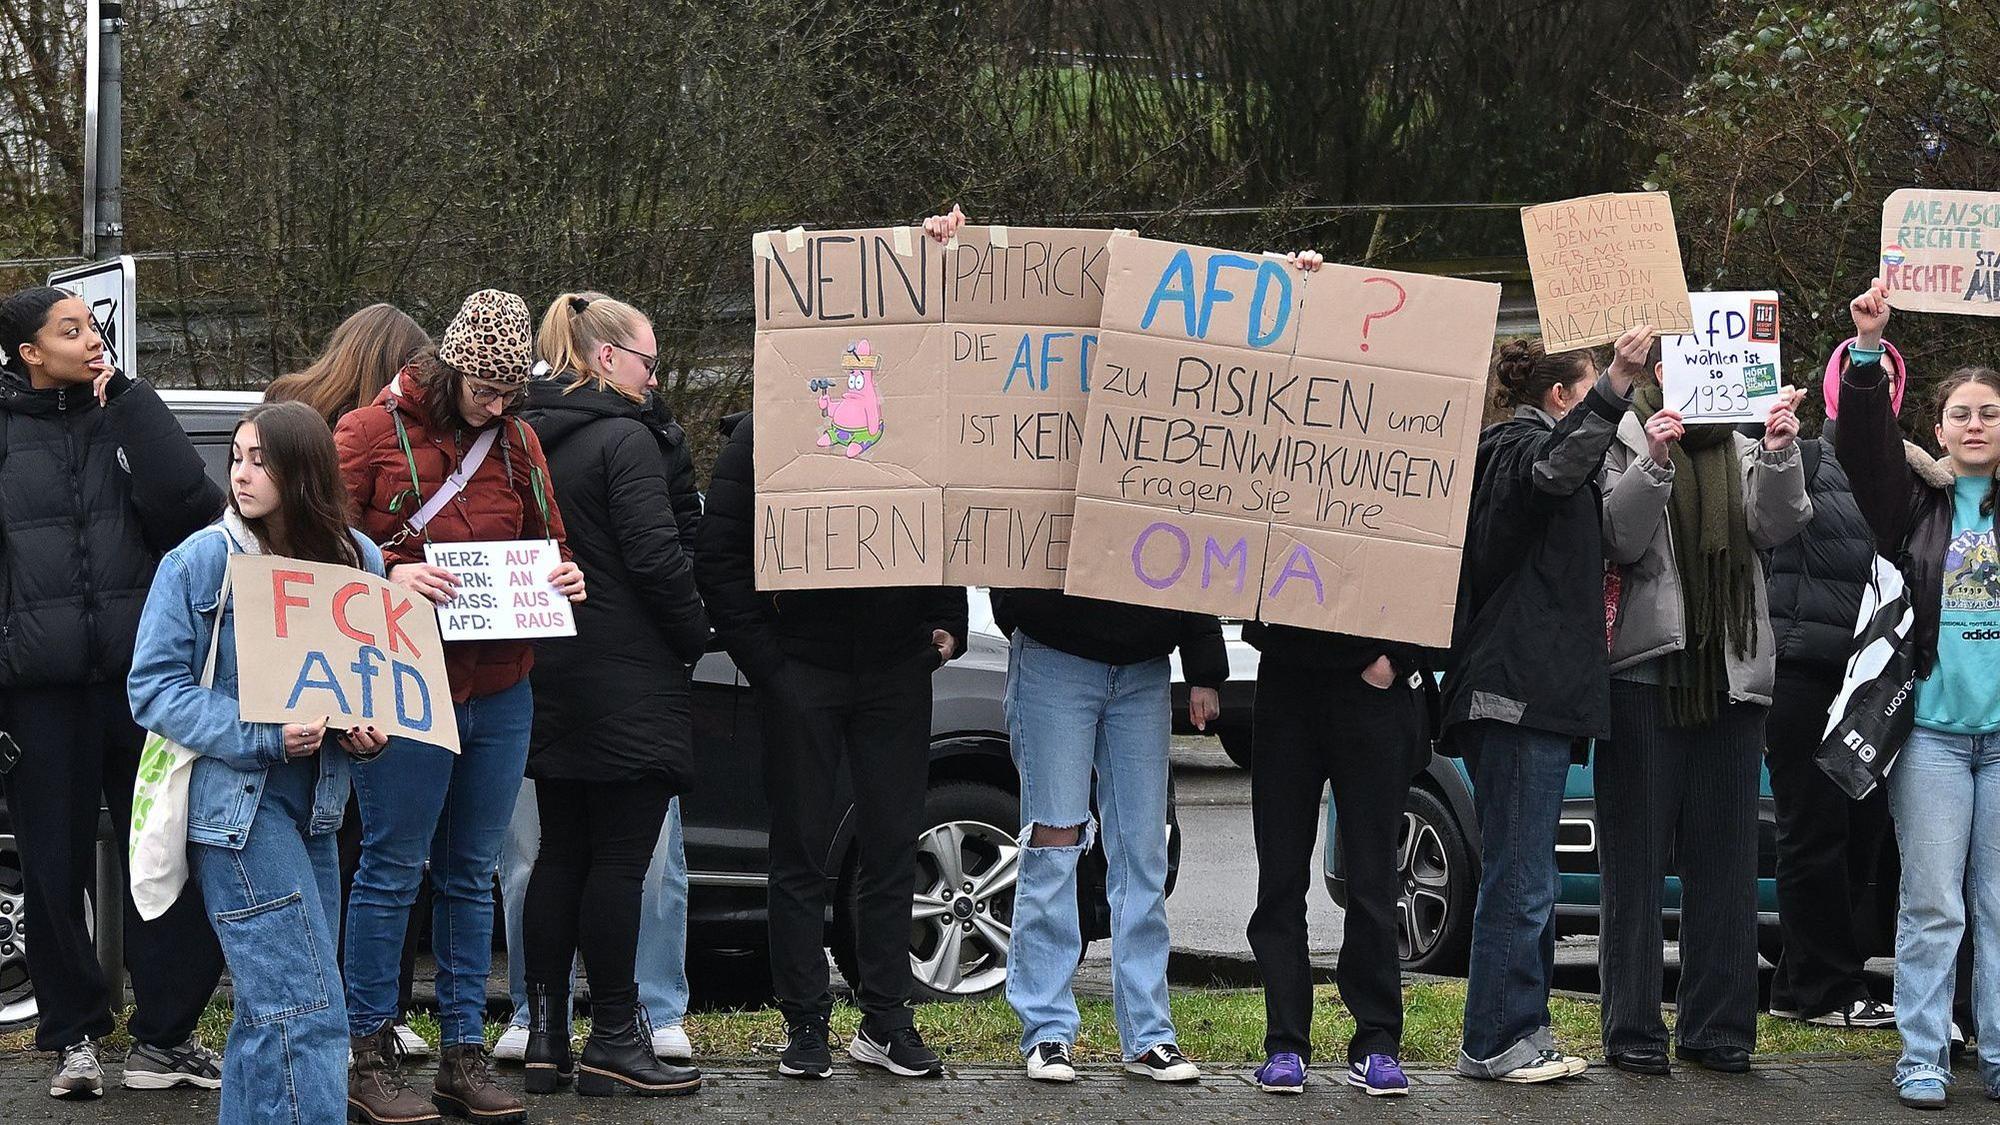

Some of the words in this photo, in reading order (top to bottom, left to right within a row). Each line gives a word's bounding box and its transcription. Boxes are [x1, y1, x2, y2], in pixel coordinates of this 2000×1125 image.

[1532, 206, 1580, 233] WER
[1588, 200, 1655, 223] NICHT
[1554, 225, 1618, 249] DENKT
[1631, 222, 1664, 234] UND
[1898, 226, 1981, 249] RECHTE
[1541, 249, 1584, 267] WER
[1594, 239, 1656, 255] NICHTS
[765, 235, 926, 320] NEIN
[955, 241, 1105, 304] PATRICK
[1548, 272, 1612, 298] GLAUBT
[1886, 264, 1964, 293] RECHTE
[1141, 248, 1292, 349] AFD
[1363, 277, 1407, 353] ?
[1566, 288, 1655, 315] GANZEN
[954, 331, 998, 362] DIE
[1744, 350, 1761, 364] ist
[1710, 369, 1723, 379] so
[1103, 363, 1147, 398] zu
[1172, 357, 1374, 434] RISIKEN
[1388, 400, 1451, 438] und
[1680, 384, 1750, 414] 1933
[960, 413, 1000, 445] IST
[1099, 412, 1455, 499] NEBENWIRKUNGEN
[1118, 466, 1233, 515] fragen
[1242, 479, 1291, 515] Sie
[1316, 488, 1384, 531] Ihre
[434, 551, 489, 567] HERZ:
[505, 550, 540, 565] AUF
[1131, 521, 1325, 605] OMA
[509, 571, 533, 587] AN
[513, 591, 549, 608] AUS
[271, 569, 421, 660] FCK
[449, 614, 492, 630] AFD:
[516, 612, 565, 629] RAUS
[285, 645, 433, 732] AfD
